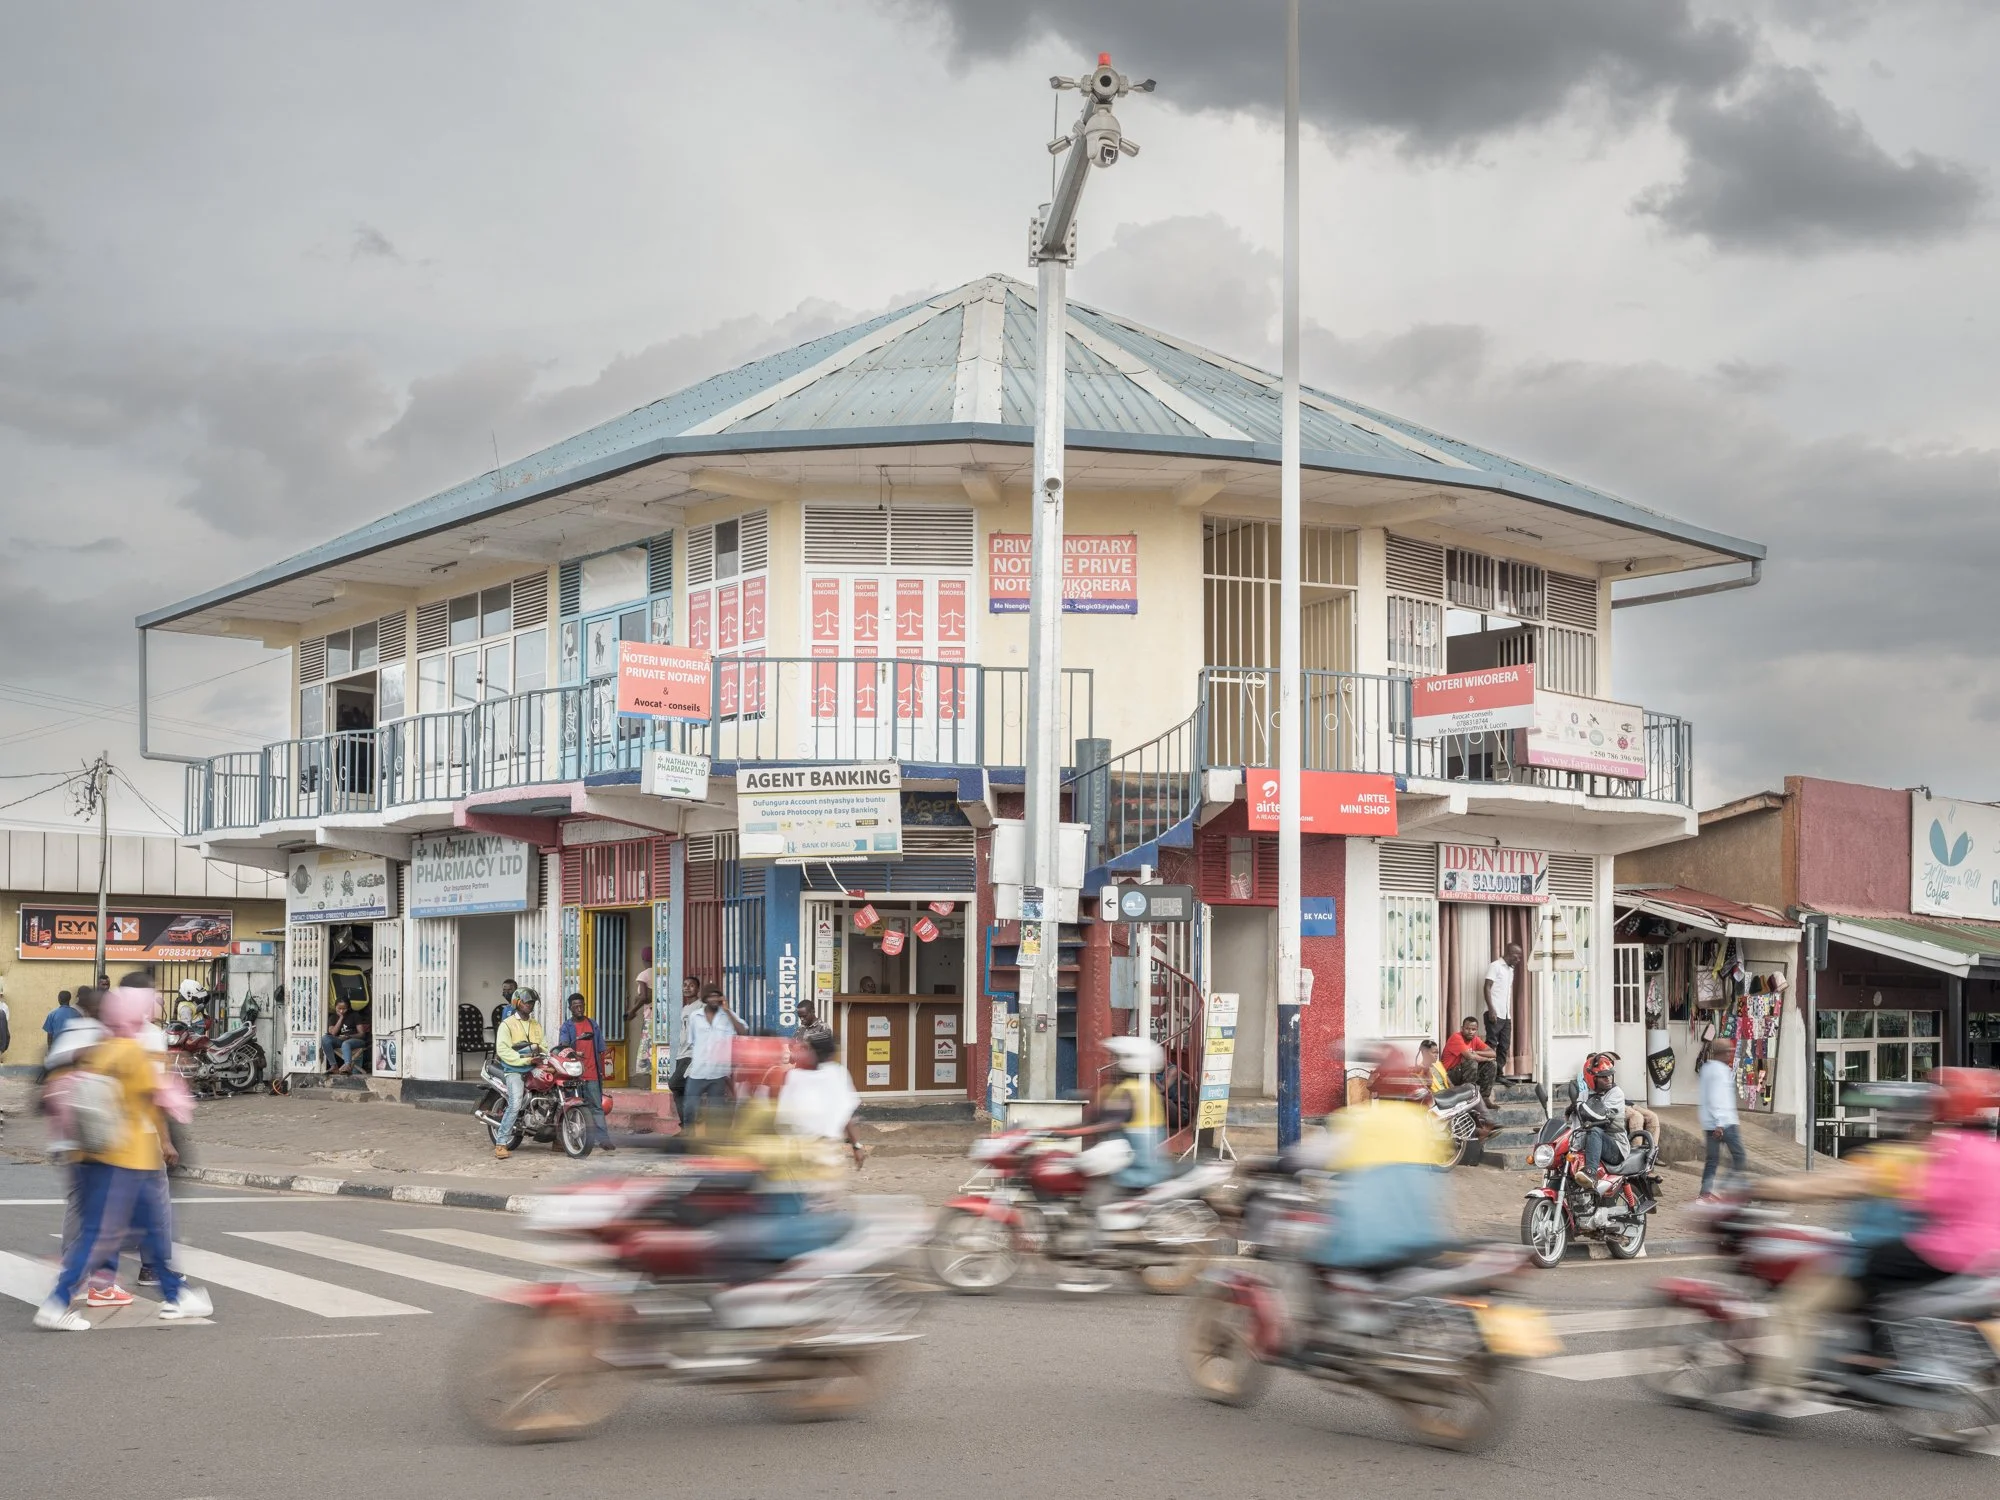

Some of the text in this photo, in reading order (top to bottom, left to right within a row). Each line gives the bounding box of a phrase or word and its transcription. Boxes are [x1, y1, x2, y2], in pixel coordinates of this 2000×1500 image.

[993, 539, 1132, 553] PRIV NOTARY
[1079, 558, 1132, 574] PRIVE
[994, 578, 1032, 591] NOTE
[1063, 591, 1092, 600] 18744
[1004, 602, 1031, 611] Nsengiy
[622, 652, 658, 666] NOTERI
[660, 657, 710, 672] WIKORERA
[626, 666, 706, 685] PRIVATE NOTARY
[1427, 671, 1519, 692] NOTERI WIKORERA
[663, 687, 669, 695] &
[634, 697, 662, 709] Avocat
[668, 700, 701, 712] conseils
[1469, 695, 1475, 704] &
[1452, 710, 1494, 720] Avocat-conseils
[1590, 749, 1606, 758] +250
[1608, 752, 1618, 760] 786
[665, 756, 698, 768] NATHANYA
[1542, 756, 1629, 775] www.faranux.com
[657, 764, 693, 775] PHARMACY
[695, 768, 706, 777] LTD
[746, 769, 891, 789] AGENT BANKING
[753, 799, 789, 807] Dufungura
[818, 796, 855, 806] nshyashya
[1357, 793, 1391, 804] AIRTEL
[761, 809, 786, 817] Dukora
[786, 808, 823, 817] Photocopy
[834, 808, 849, 816] Easy
[851, 806, 878, 814] Banking
[1256, 800, 1280, 813] airte
[1340, 803, 1391, 815] MINI SHOP
[433, 836, 504, 860] NATHANYA
[802, 840, 820, 849] BANK
[820, 839, 830, 848] OF
[831, 839, 851, 848] KIGALI
[1443, 845, 1543, 875] IDENTITY
[416, 855, 523, 884] PHARMACY LTD
[443, 882, 489, 892] Our Insurance Partners
[1472, 873, 1520, 893] SALOON
[1925, 880, 1949, 906] Coffee
[1992, 879, 2000, 907] C
[1303, 912, 1333, 920] BK YACU
[58, 917, 137, 934] RYMAX
[158, 947, 212, 957] 0788341176
[779, 943, 796, 1026] IREMBO
